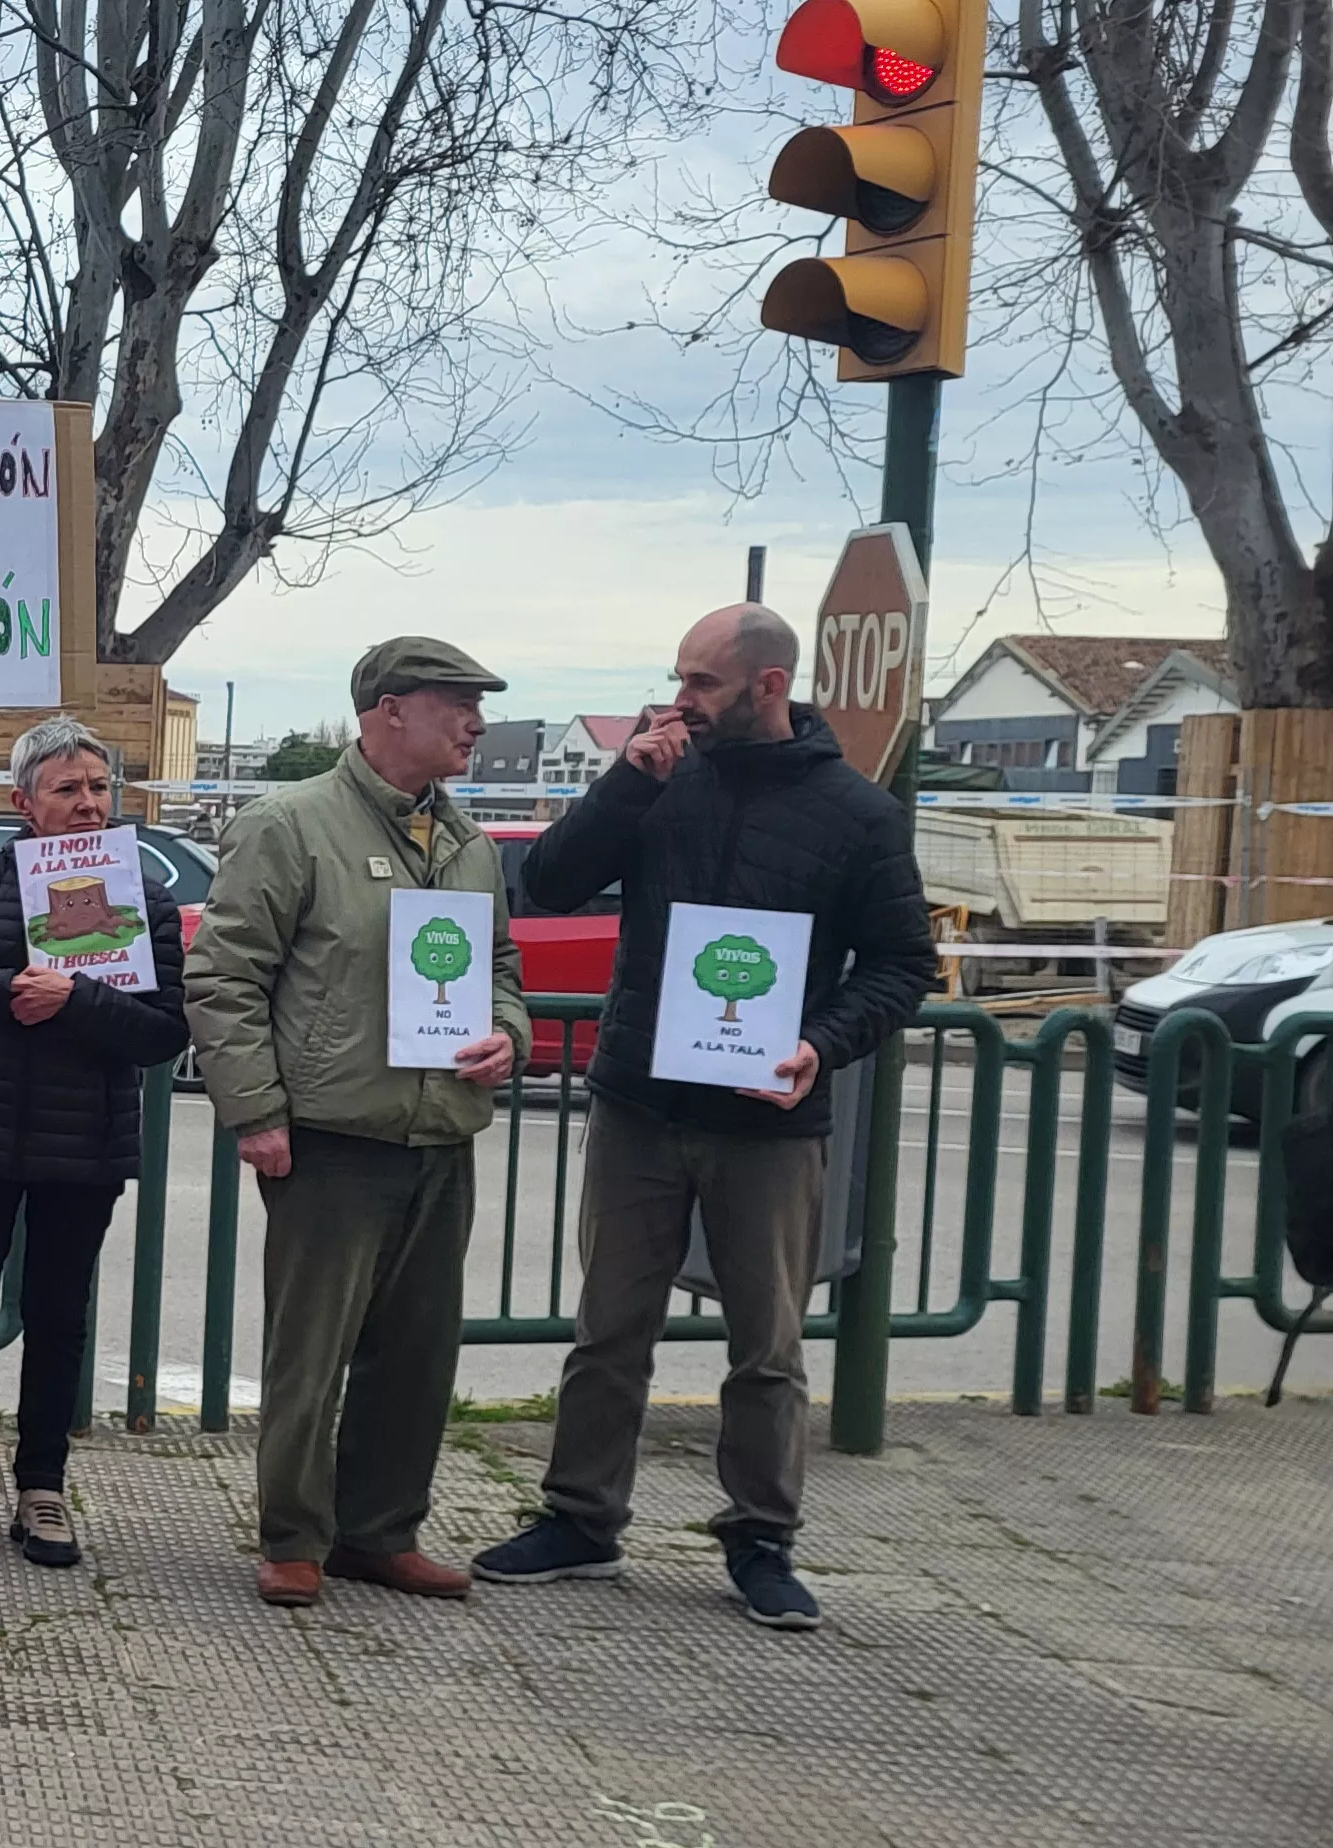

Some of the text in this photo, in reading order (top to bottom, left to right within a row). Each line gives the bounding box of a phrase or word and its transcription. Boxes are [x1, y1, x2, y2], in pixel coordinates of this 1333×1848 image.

[816, 611, 908, 712] STOP
[29, 862, 42, 875] A
[45, 861, 67, 873] LA
[425, 931, 459, 945] VIVOS
[63, 950, 129, 969] HUESCA
[714, 948, 761, 964] VIVOS
[436, 1010, 452, 1018] NO
[417, 1026, 470, 1036] A LA TALA
[720, 1026, 742, 1036] NO
[692, 1040, 766, 1056] A LA TALA
